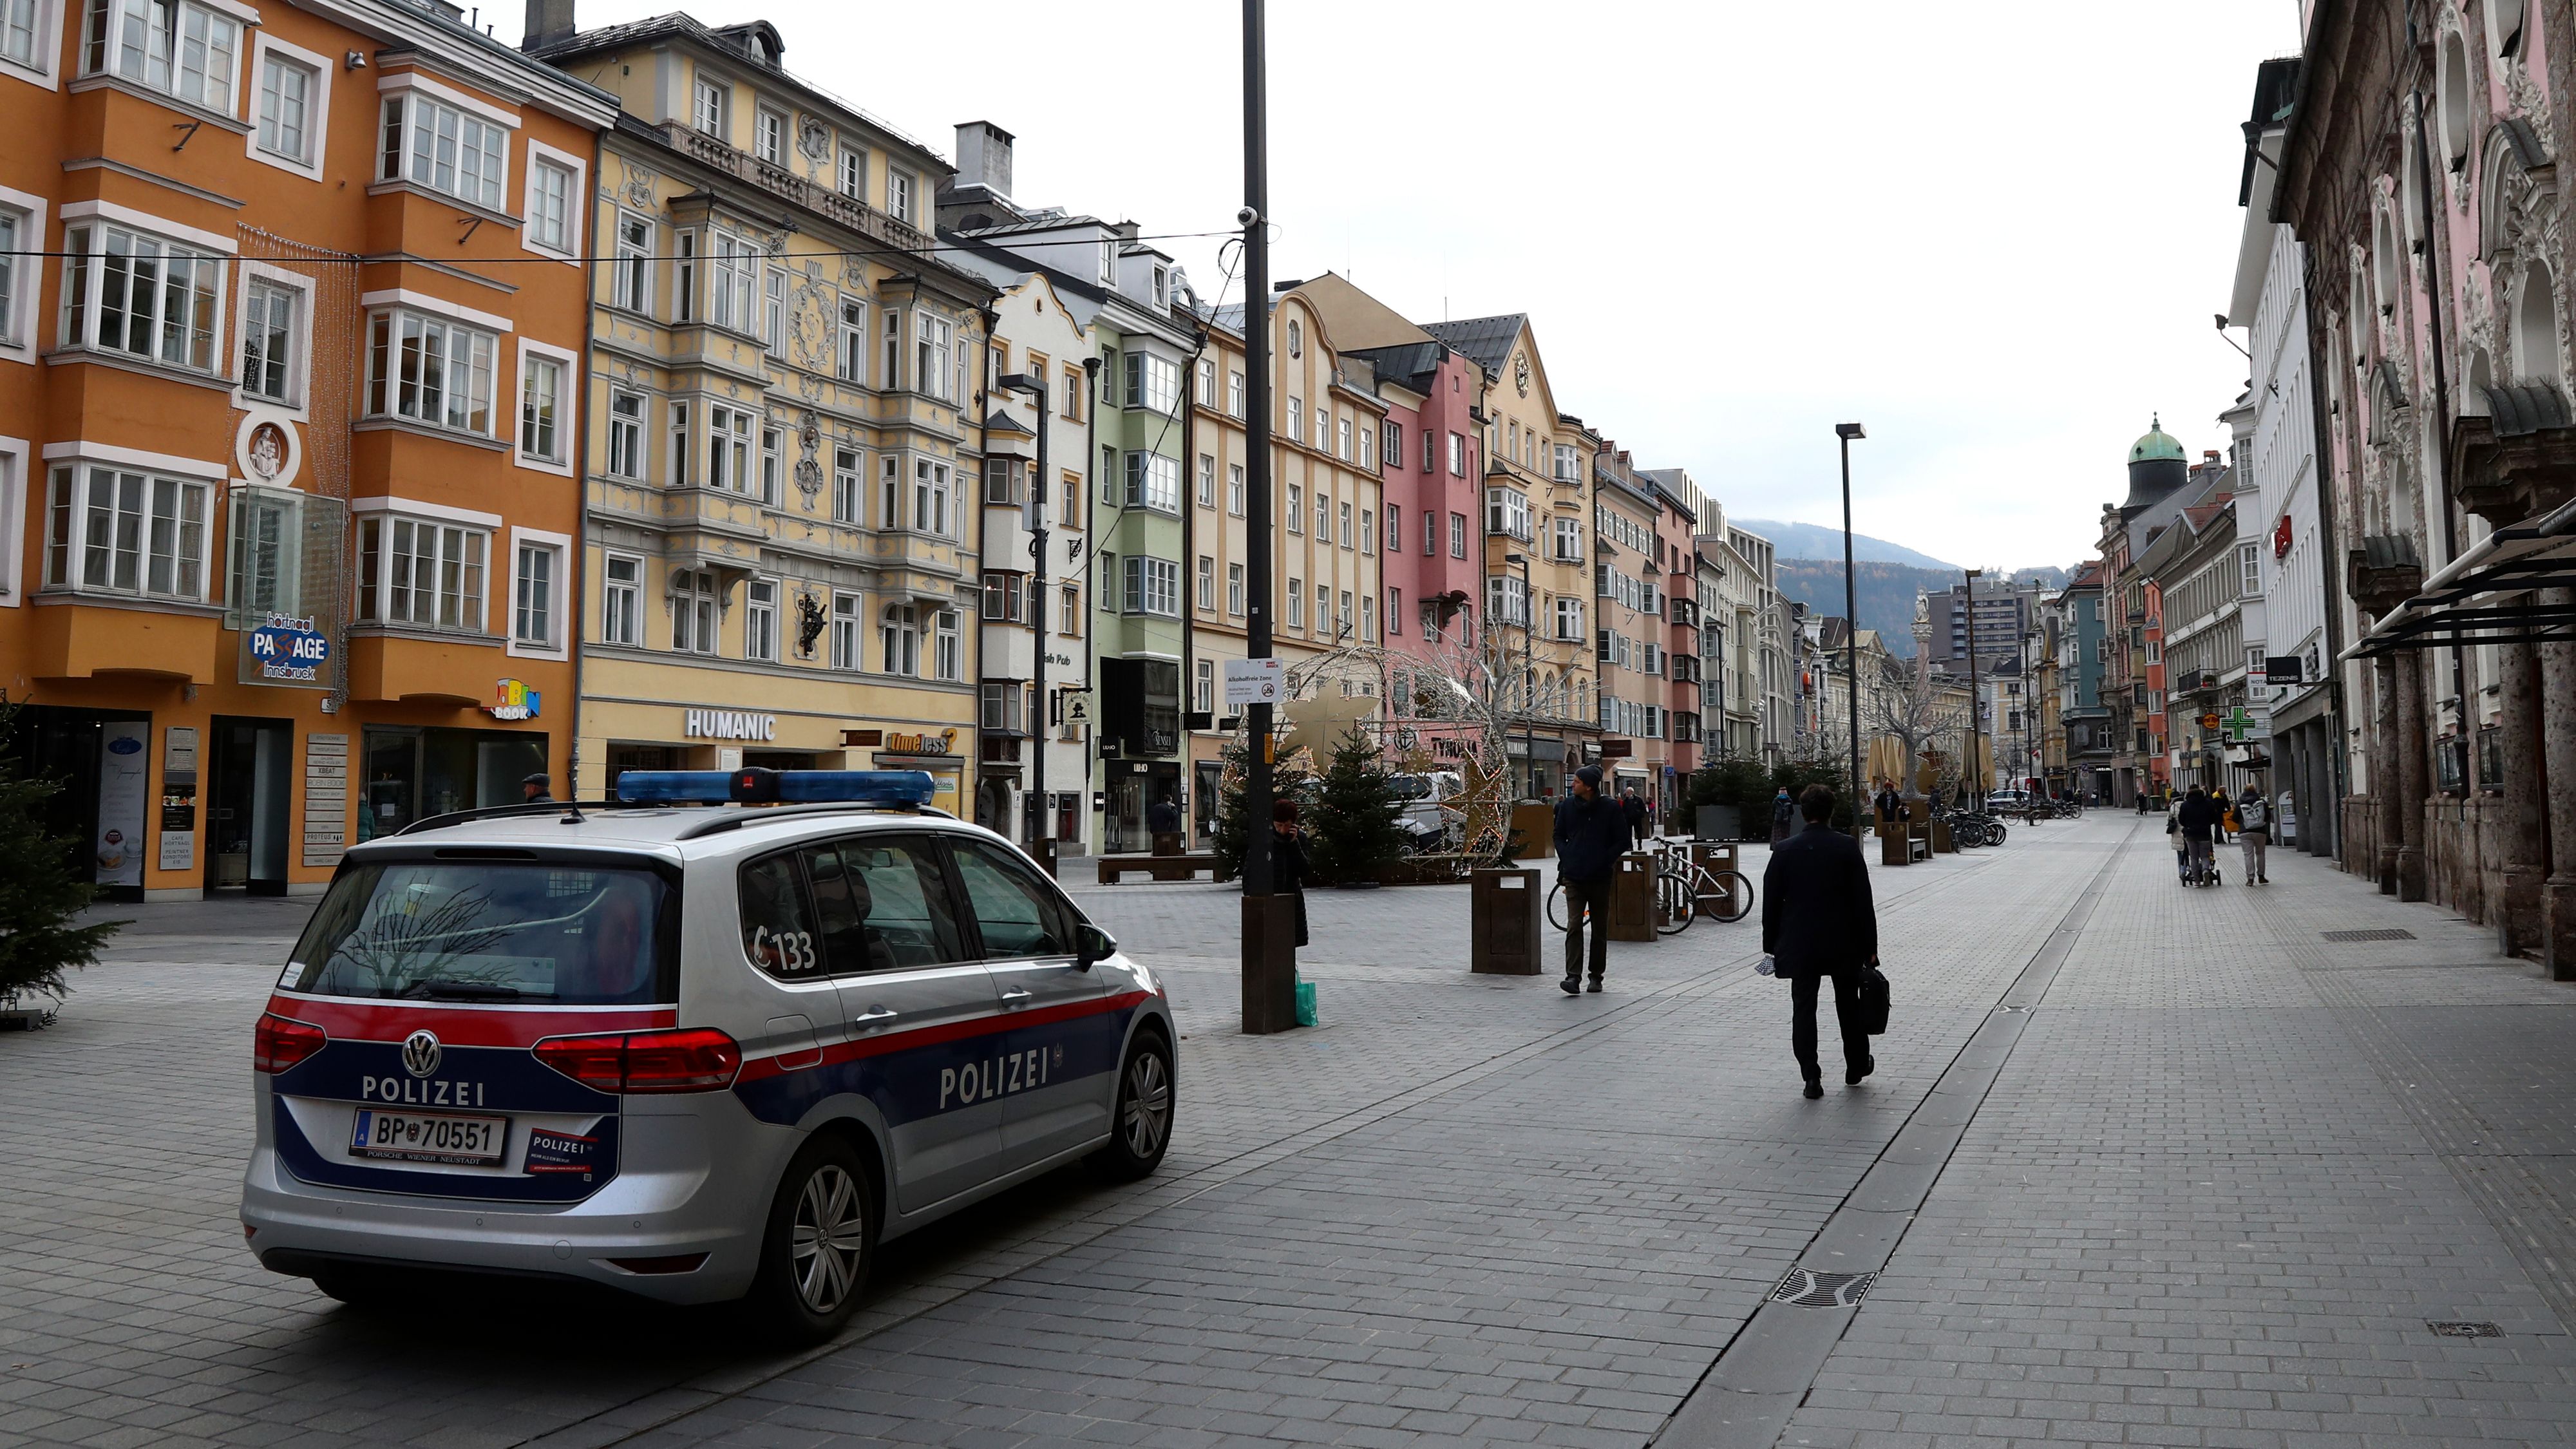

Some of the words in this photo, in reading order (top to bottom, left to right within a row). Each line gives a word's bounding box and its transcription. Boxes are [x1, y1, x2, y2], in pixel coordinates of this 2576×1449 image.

[1057, 654, 1071, 666] Pub
[264, 660, 316, 681] Innsbruck
[495, 706, 529, 720] BOOK
[685, 710, 777, 741] HUMANIC
[1155, 735, 1171, 746] SENSEI
[772, 931, 815, 971] 133
[940, 1046, 1047, 1110] POLIZEI
[363, 1075, 484, 1106] POLIZEI
[358, 1133, 365, 1142] A
[376, 1117, 406, 1144] BP
[422, 1120, 491, 1151] 70551
[533, 1136, 584, 1154] POLIZEI
[367, 1150, 402, 1160] PORSCHE
[407, 1153, 436, 1162] WIENER
[440, 1156, 482, 1166] NEUSTADT
